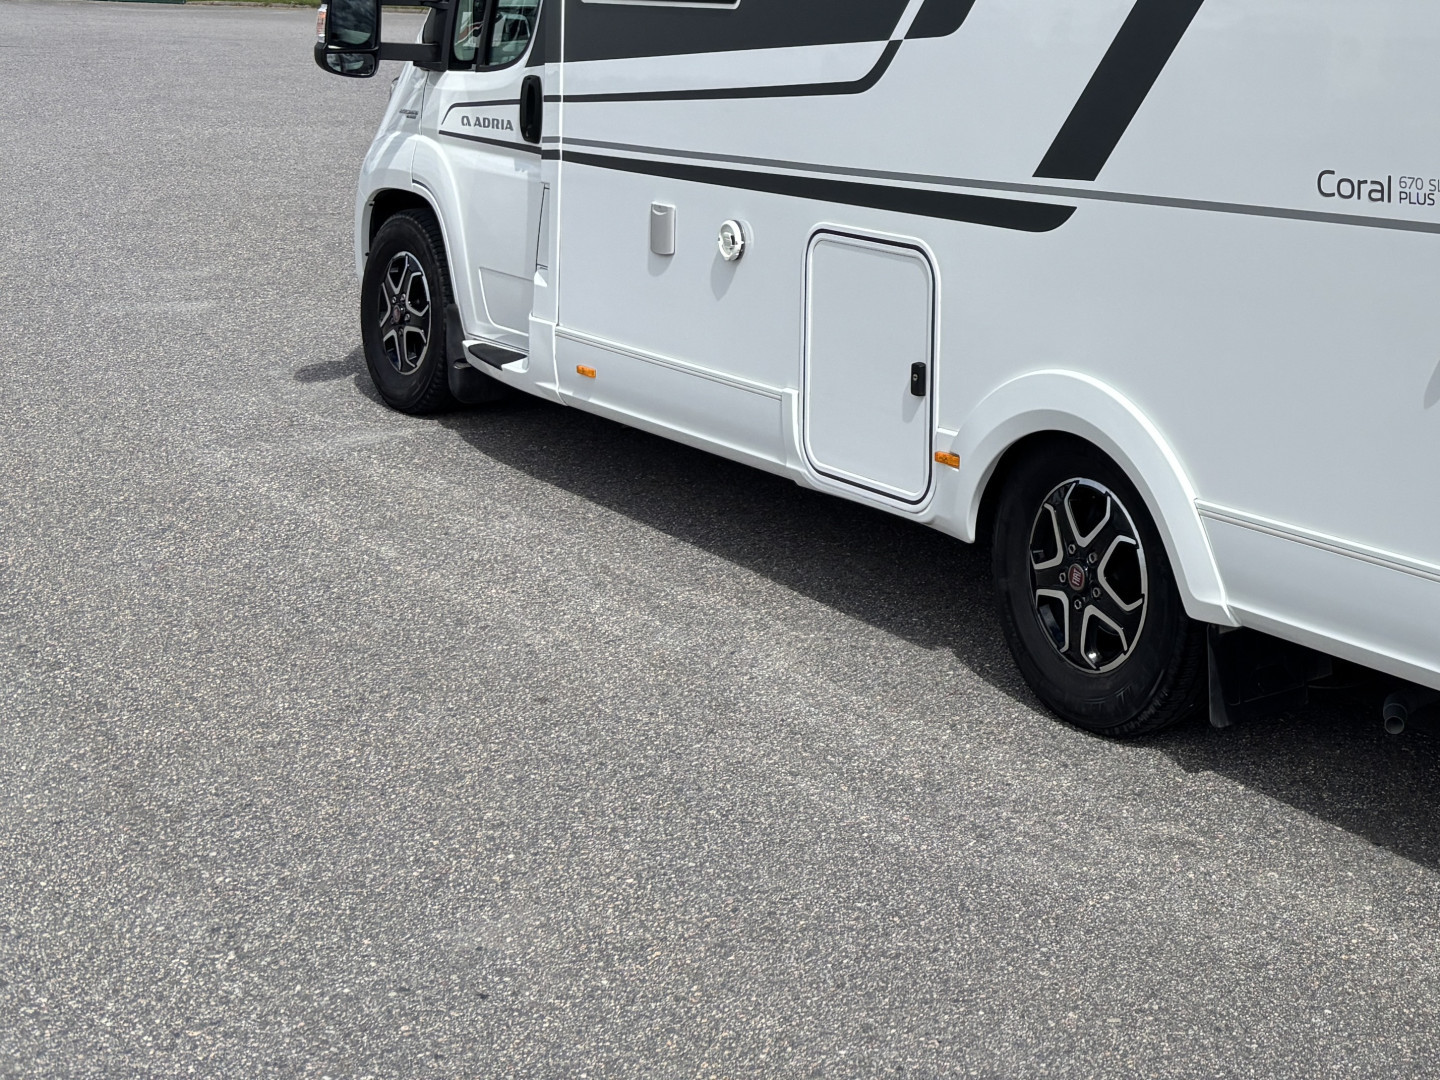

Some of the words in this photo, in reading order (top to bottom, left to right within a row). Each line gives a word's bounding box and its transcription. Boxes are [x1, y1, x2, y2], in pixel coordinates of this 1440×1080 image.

[473, 116, 514, 131] ADRIA
[1317, 169, 1392, 204] Coral
[1399, 176, 1424, 191] 670
[1399, 191, 1436, 206] PLUS
